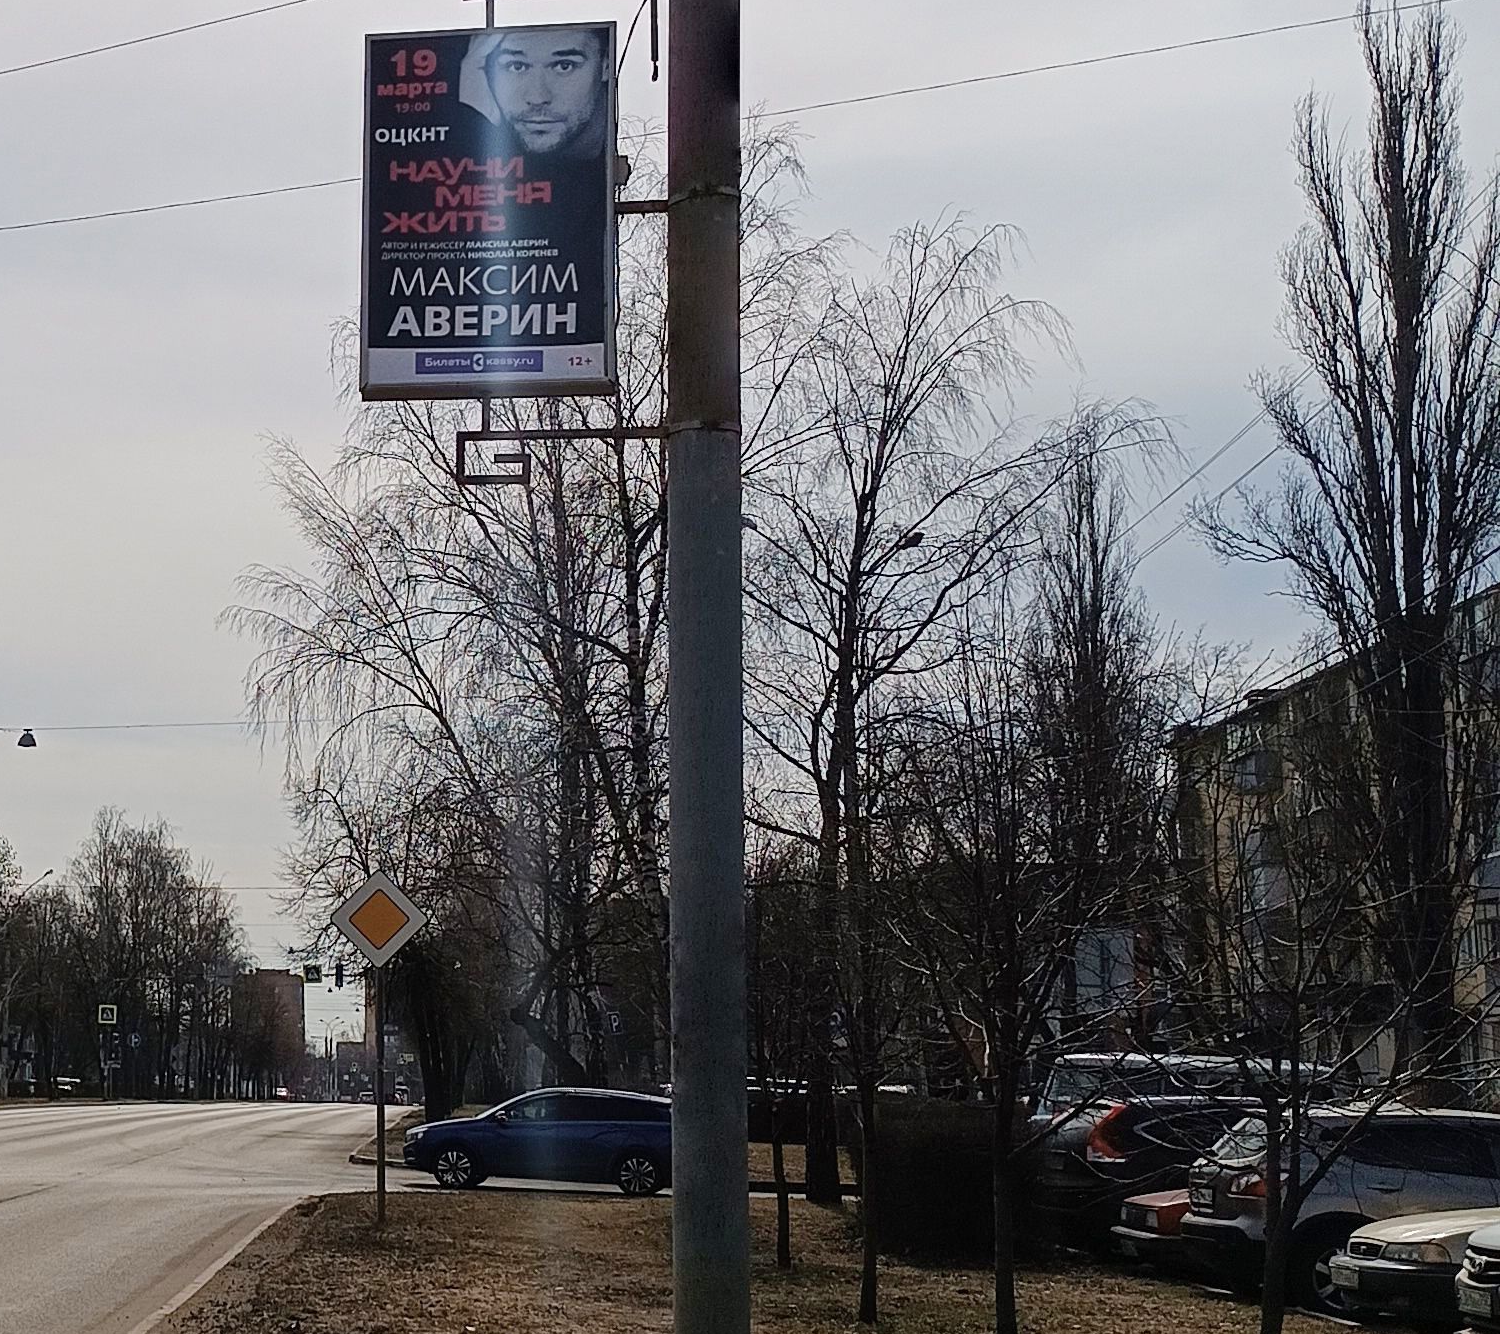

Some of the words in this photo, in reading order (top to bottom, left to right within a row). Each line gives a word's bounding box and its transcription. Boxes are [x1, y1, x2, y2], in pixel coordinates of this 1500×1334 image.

[390, 49, 437, 76] 19
[377, 81, 447, 98] марта
[395, 102, 431, 113] 19:00
[375, 126, 449, 146] ОЦКНТ
[389, 156, 523, 185] НАУЧИ
[435, 181, 552, 207] МЕНЯ
[381, 211, 506, 233] ЖИТЬ
[381, 241, 409, 250] АВТОР
[466, 239, 509, 249] МАКСИМ
[511, 238, 549, 248] АВЕРИН
[381, 251, 426, 260] ДИРЕКТОР
[427, 251, 467, 259] ПРОЕКТА
[468, 248, 514, 259] НИКОЛАЙ
[389, 263, 579, 296] МАКСИМ
[387, 302, 577, 337] АВЕРИН
[425, 357, 470, 367] Билеты
[568, 356, 593, 367] 12+
